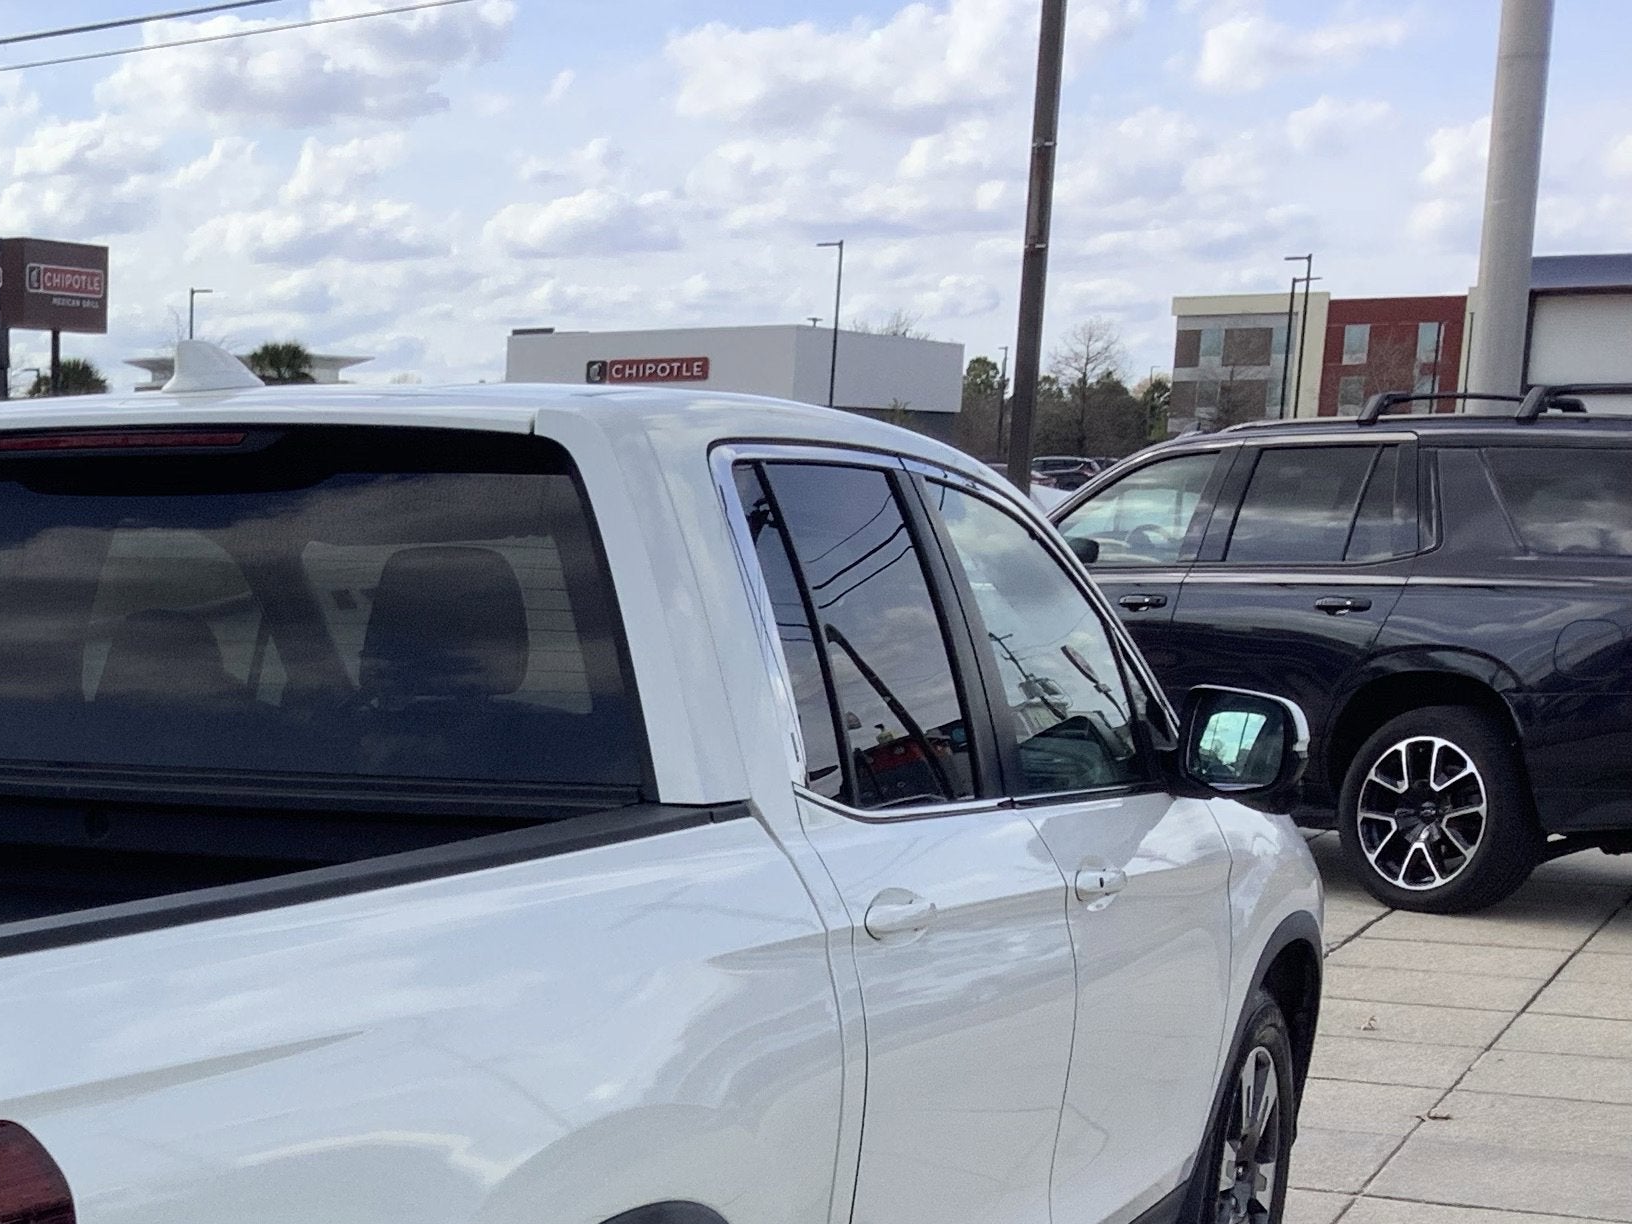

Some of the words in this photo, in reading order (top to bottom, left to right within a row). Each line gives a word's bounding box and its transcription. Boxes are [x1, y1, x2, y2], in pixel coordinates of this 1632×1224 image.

[44, 272, 100, 291] CHIPOTLE
[52, 297, 81, 307] MEXICAN
[81, 300, 100, 308] GRILL
[611, 361, 704, 379] CHIPOTLE
